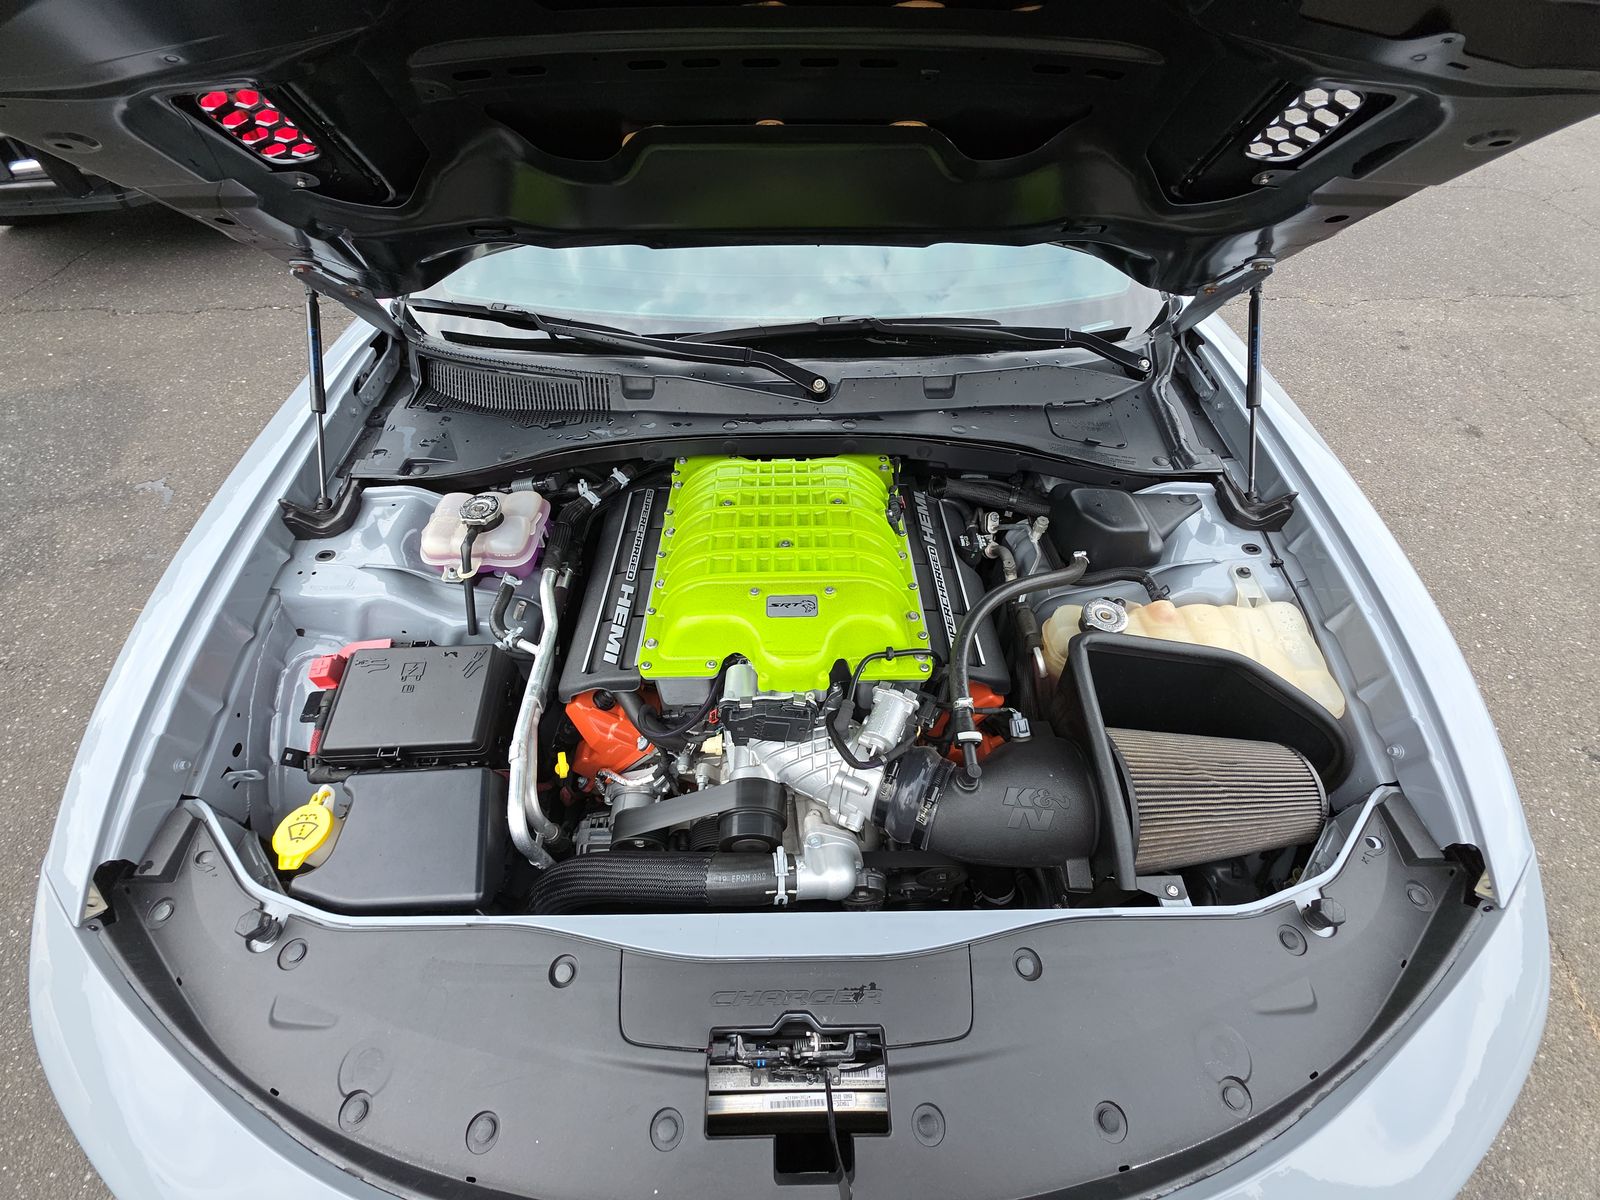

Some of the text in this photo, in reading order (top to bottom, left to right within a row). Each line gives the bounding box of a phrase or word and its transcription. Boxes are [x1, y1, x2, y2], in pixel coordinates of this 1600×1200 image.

[603, 489, 654, 665] SUPERCHARGED HEMI
[913, 491, 957, 648] PERCHARGED HEMI
[711, 989, 882, 1007] CHARGER
